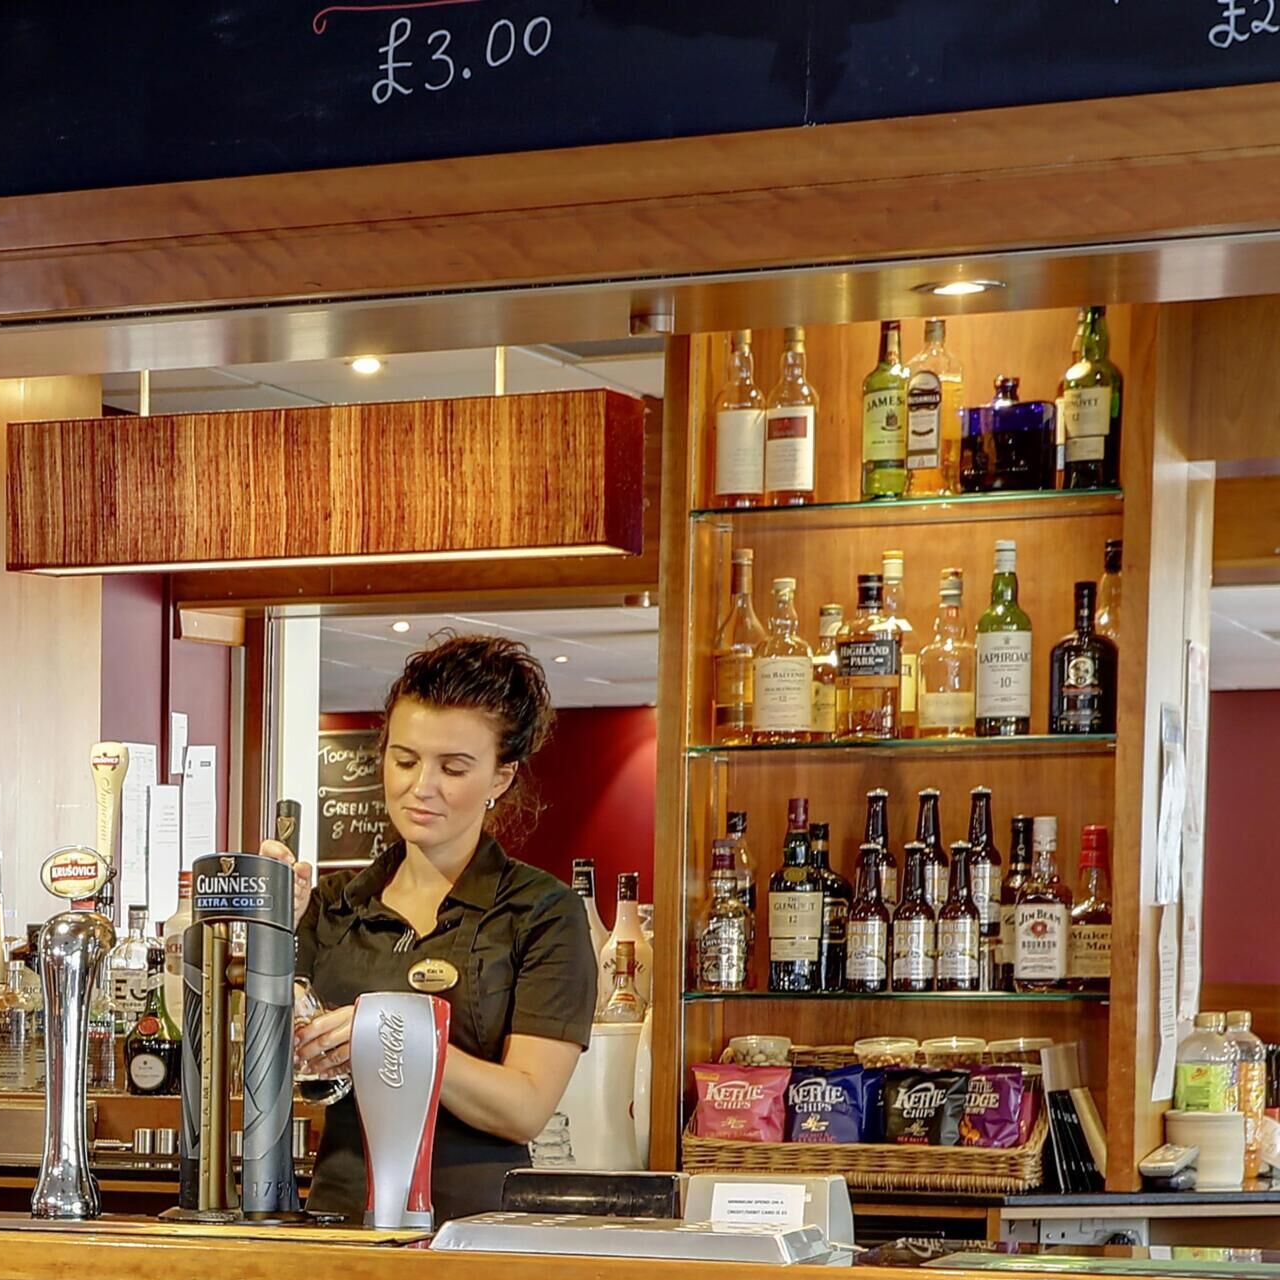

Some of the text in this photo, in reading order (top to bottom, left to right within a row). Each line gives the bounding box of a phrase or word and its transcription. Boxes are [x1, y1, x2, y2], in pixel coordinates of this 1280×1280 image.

[371, 17, 552, 104] £3.00
[840, 645, 889, 657] HIGHLAND
[851, 656, 875, 667] PARK
[1000, 676, 1012, 688] 10
[323, 800, 368, 818] GREEN
[350, 817, 387, 834] MINT
[197, 874, 267, 894] GUINNESS
[197, 897, 264, 907] EXTRA COLD
[1022, 940, 1057, 949] BOURBON
[705, 1080, 766, 1102] KETTLE
[788, 1077, 845, 1105] KETTLE
[892, 1082, 948, 1110] KETTLE
[714, 1101, 752, 1110] CHIPS
[795, 1103, 833, 1113] CHIPS
[903, 1108, 935, 1119] CHIPS
